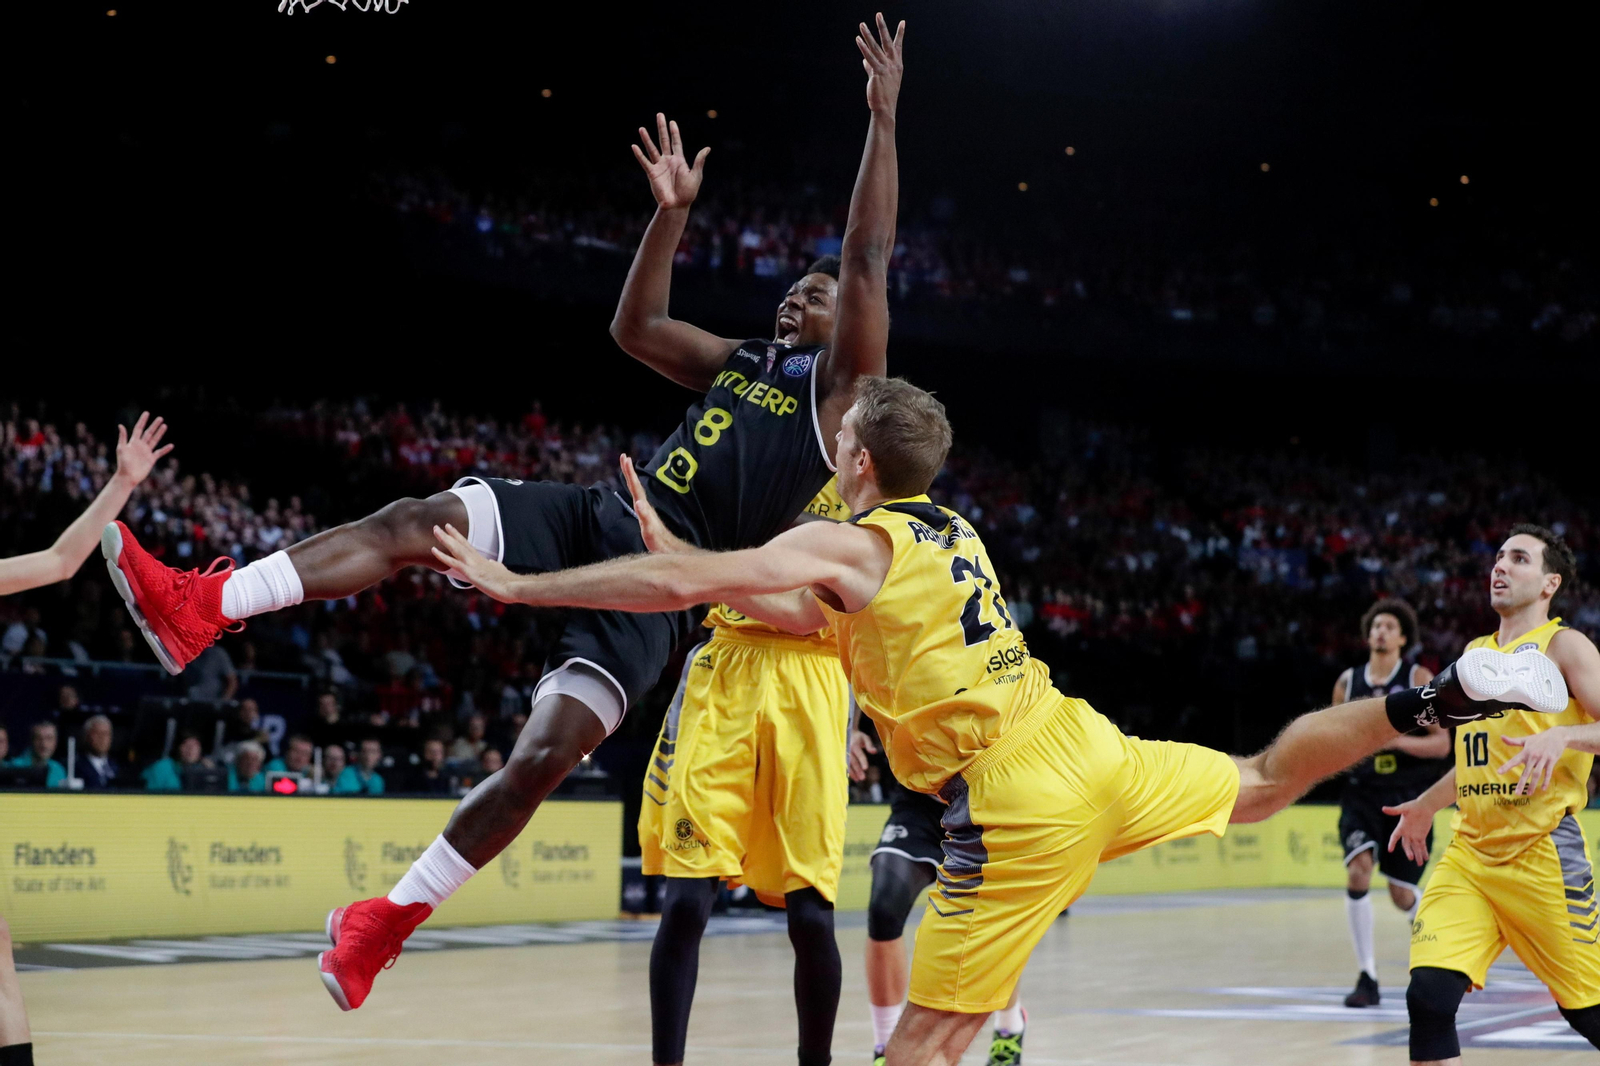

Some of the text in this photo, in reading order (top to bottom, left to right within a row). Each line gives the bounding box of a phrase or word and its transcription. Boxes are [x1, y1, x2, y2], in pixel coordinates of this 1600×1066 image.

[711, 370, 798, 417] NTWERP
[694, 407, 733, 446] 8
[1463, 732, 1489, 767] 10
[14, 842, 97, 866] Flanders
[209, 841, 283, 865] Flanders
[674, 839, 711, 851] LAGUNA
